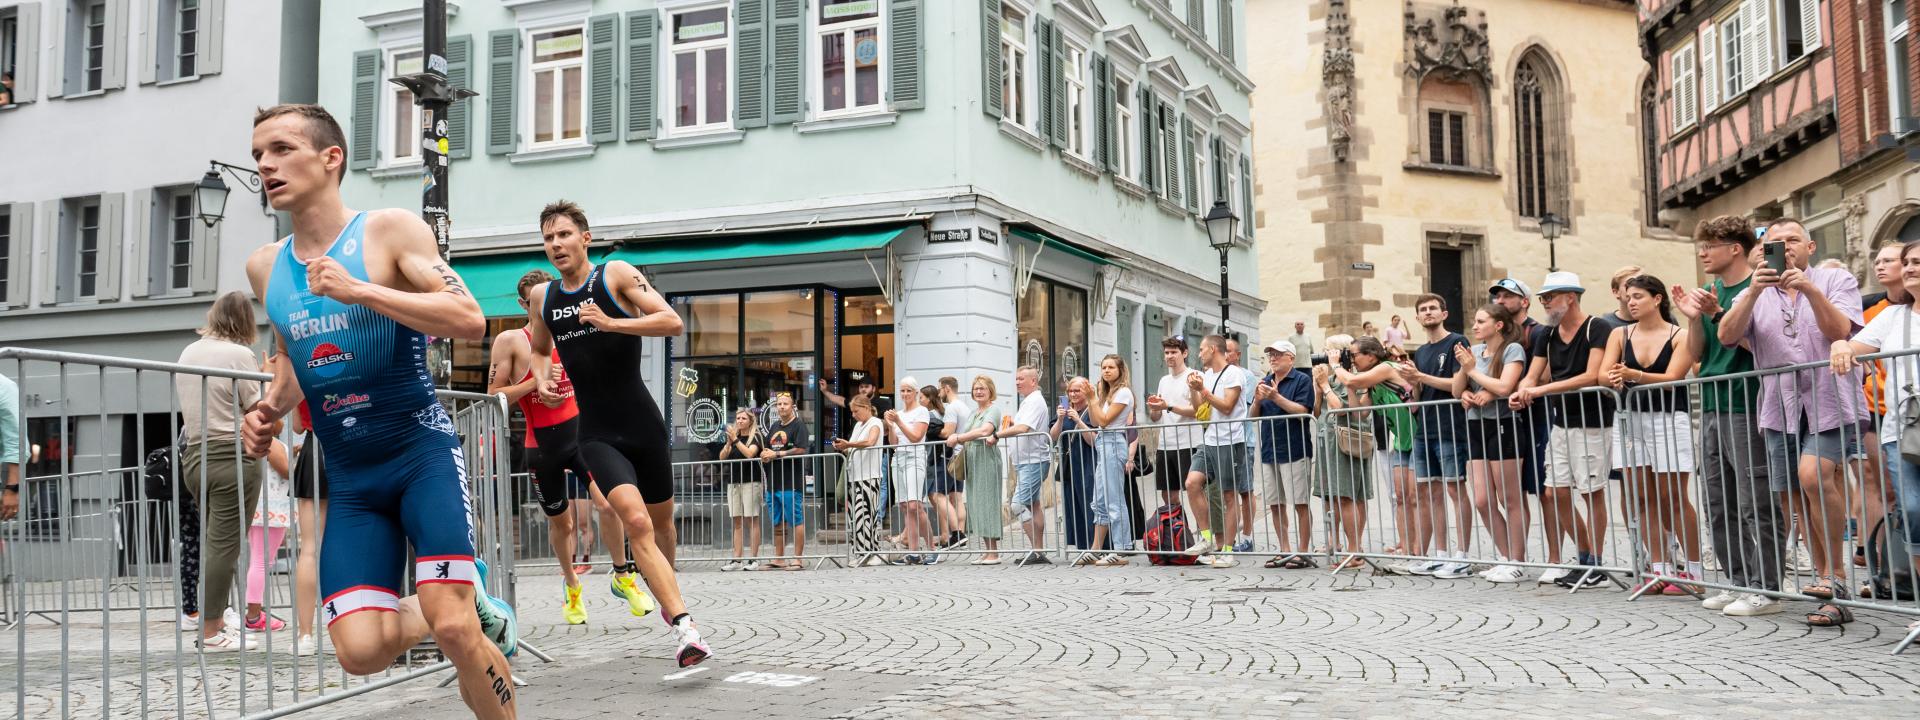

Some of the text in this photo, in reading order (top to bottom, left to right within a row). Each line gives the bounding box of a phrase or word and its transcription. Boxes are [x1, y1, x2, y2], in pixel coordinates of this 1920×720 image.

[930, 229, 969, 241] Neue Straße
[288, 309, 310, 323] TEAM
[290, 312, 349, 341] BERLIN
[556, 329, 586, 342] PanTum
